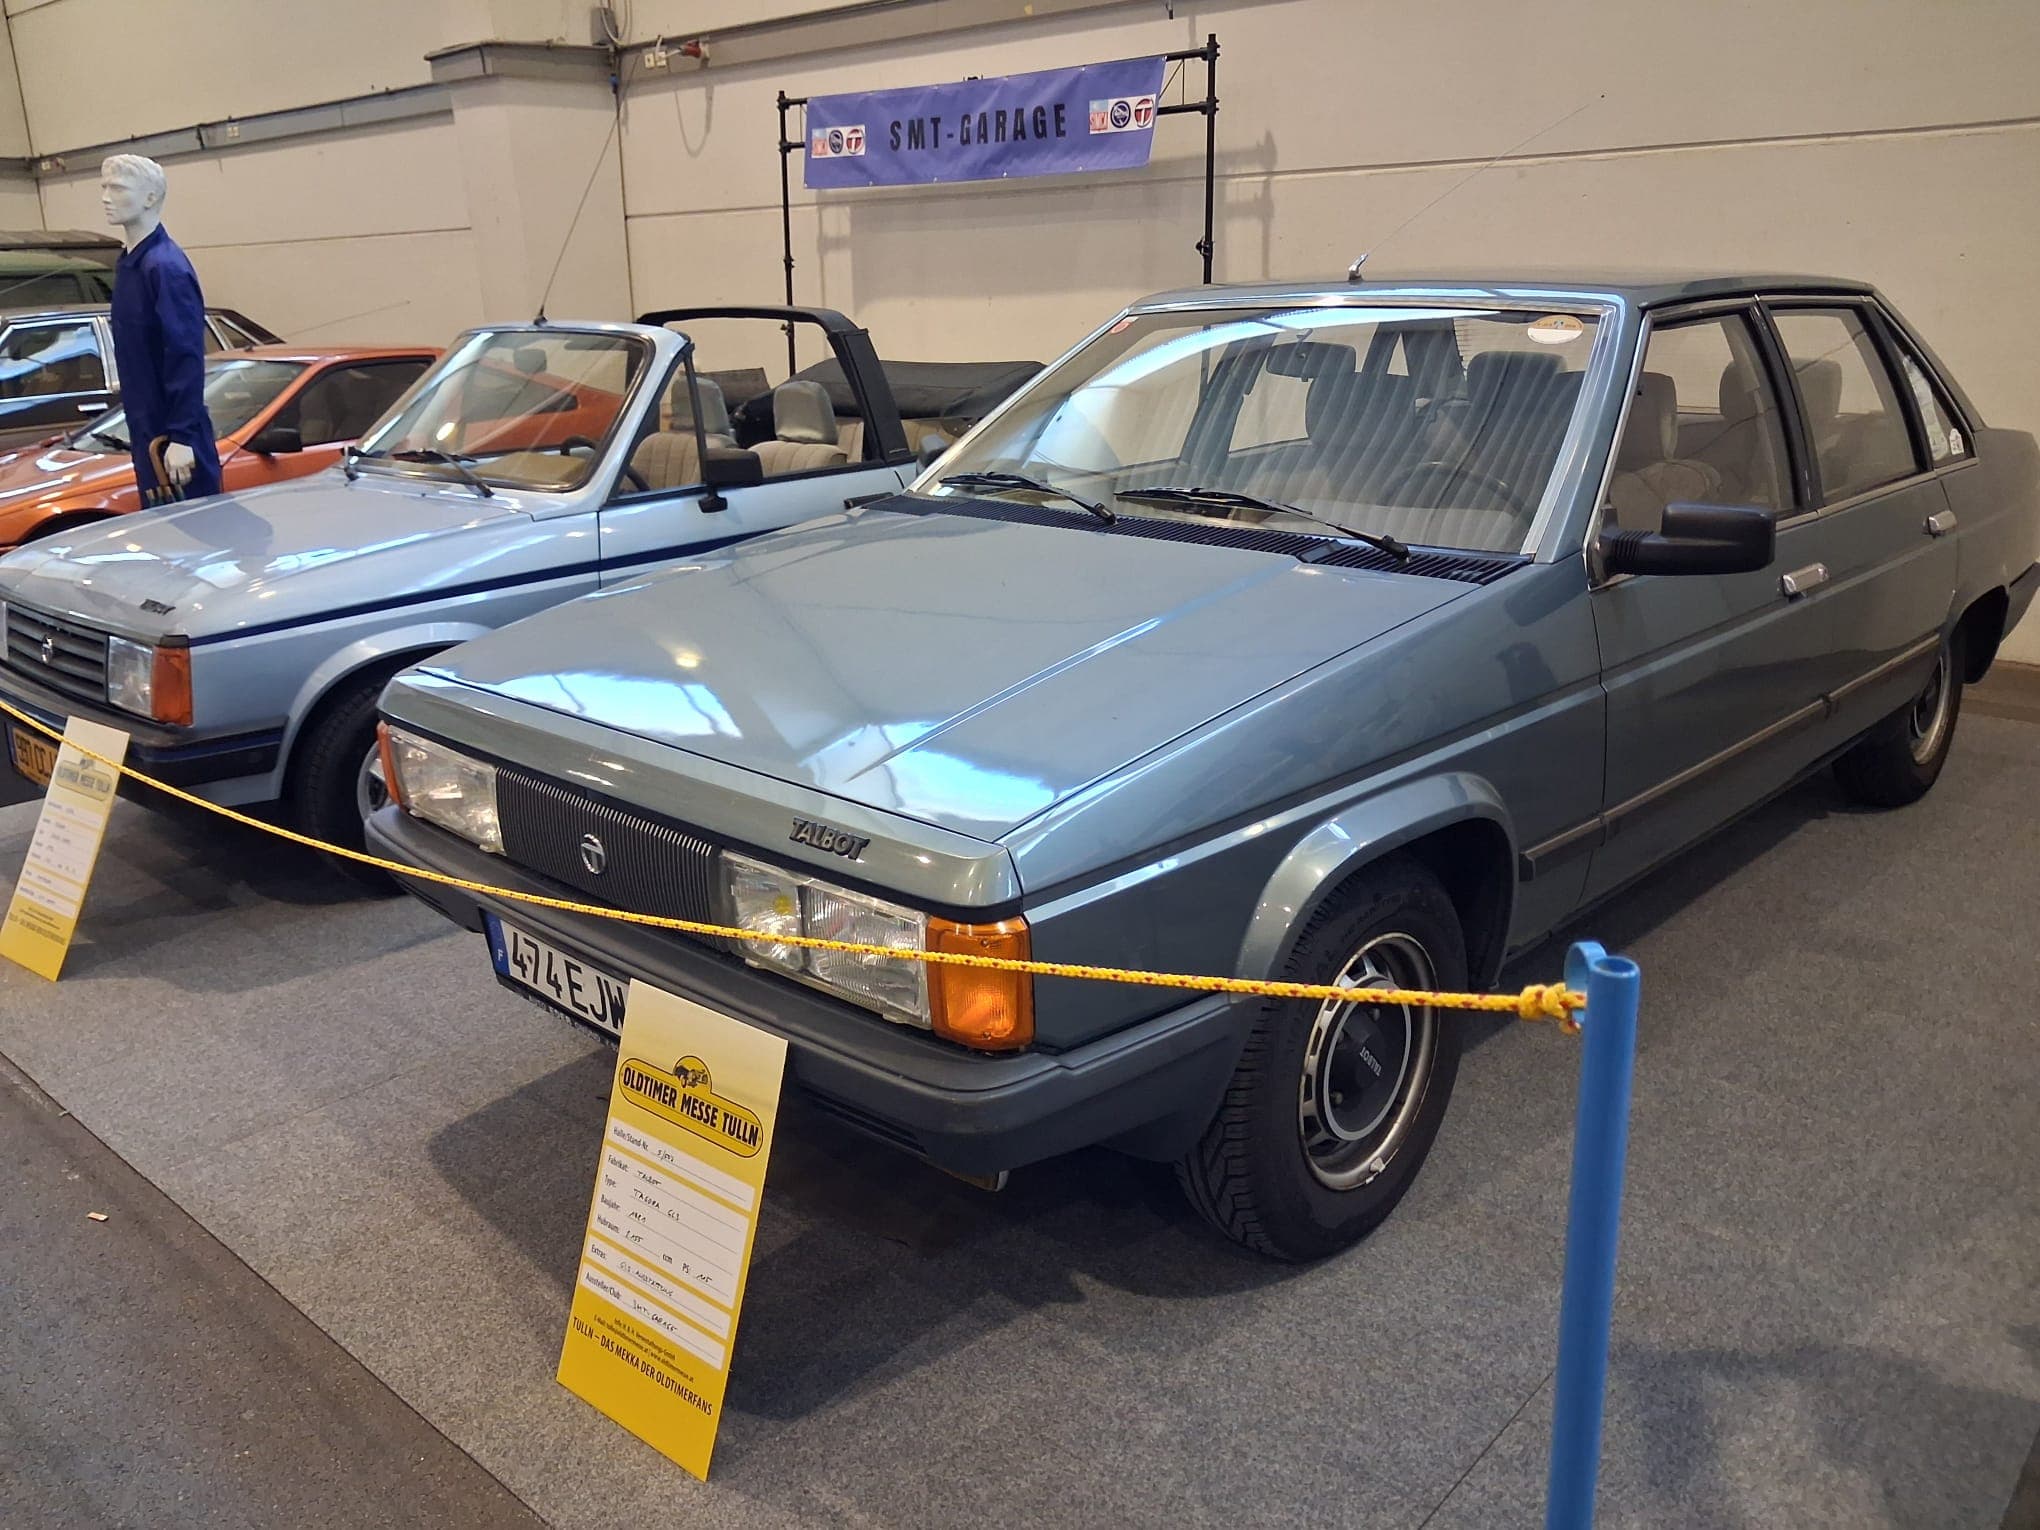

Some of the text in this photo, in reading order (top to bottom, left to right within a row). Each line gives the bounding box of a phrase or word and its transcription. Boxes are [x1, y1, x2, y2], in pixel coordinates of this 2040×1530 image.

[889, 103, 1067, 151] SMT-GARAGE
[789, 816, 871, 860] TALBOT
[497, 948, 503, 961] F
[1360, 1046, 1382, 1077] TALBOT
[623, 1067, 759, 1147] OLDTIMER MESSE TULLN
[682, 1263, 690, 1274] PS
[573, 1316, 594, 1340] TULLN
[600, 1335, 614, 1354] DAS
[615, 1345, 640, 1371] MEKKA
[640, 1361, 656, 1380] DER
[656, 1371, 713, 1416] OLDTIMERFANS
